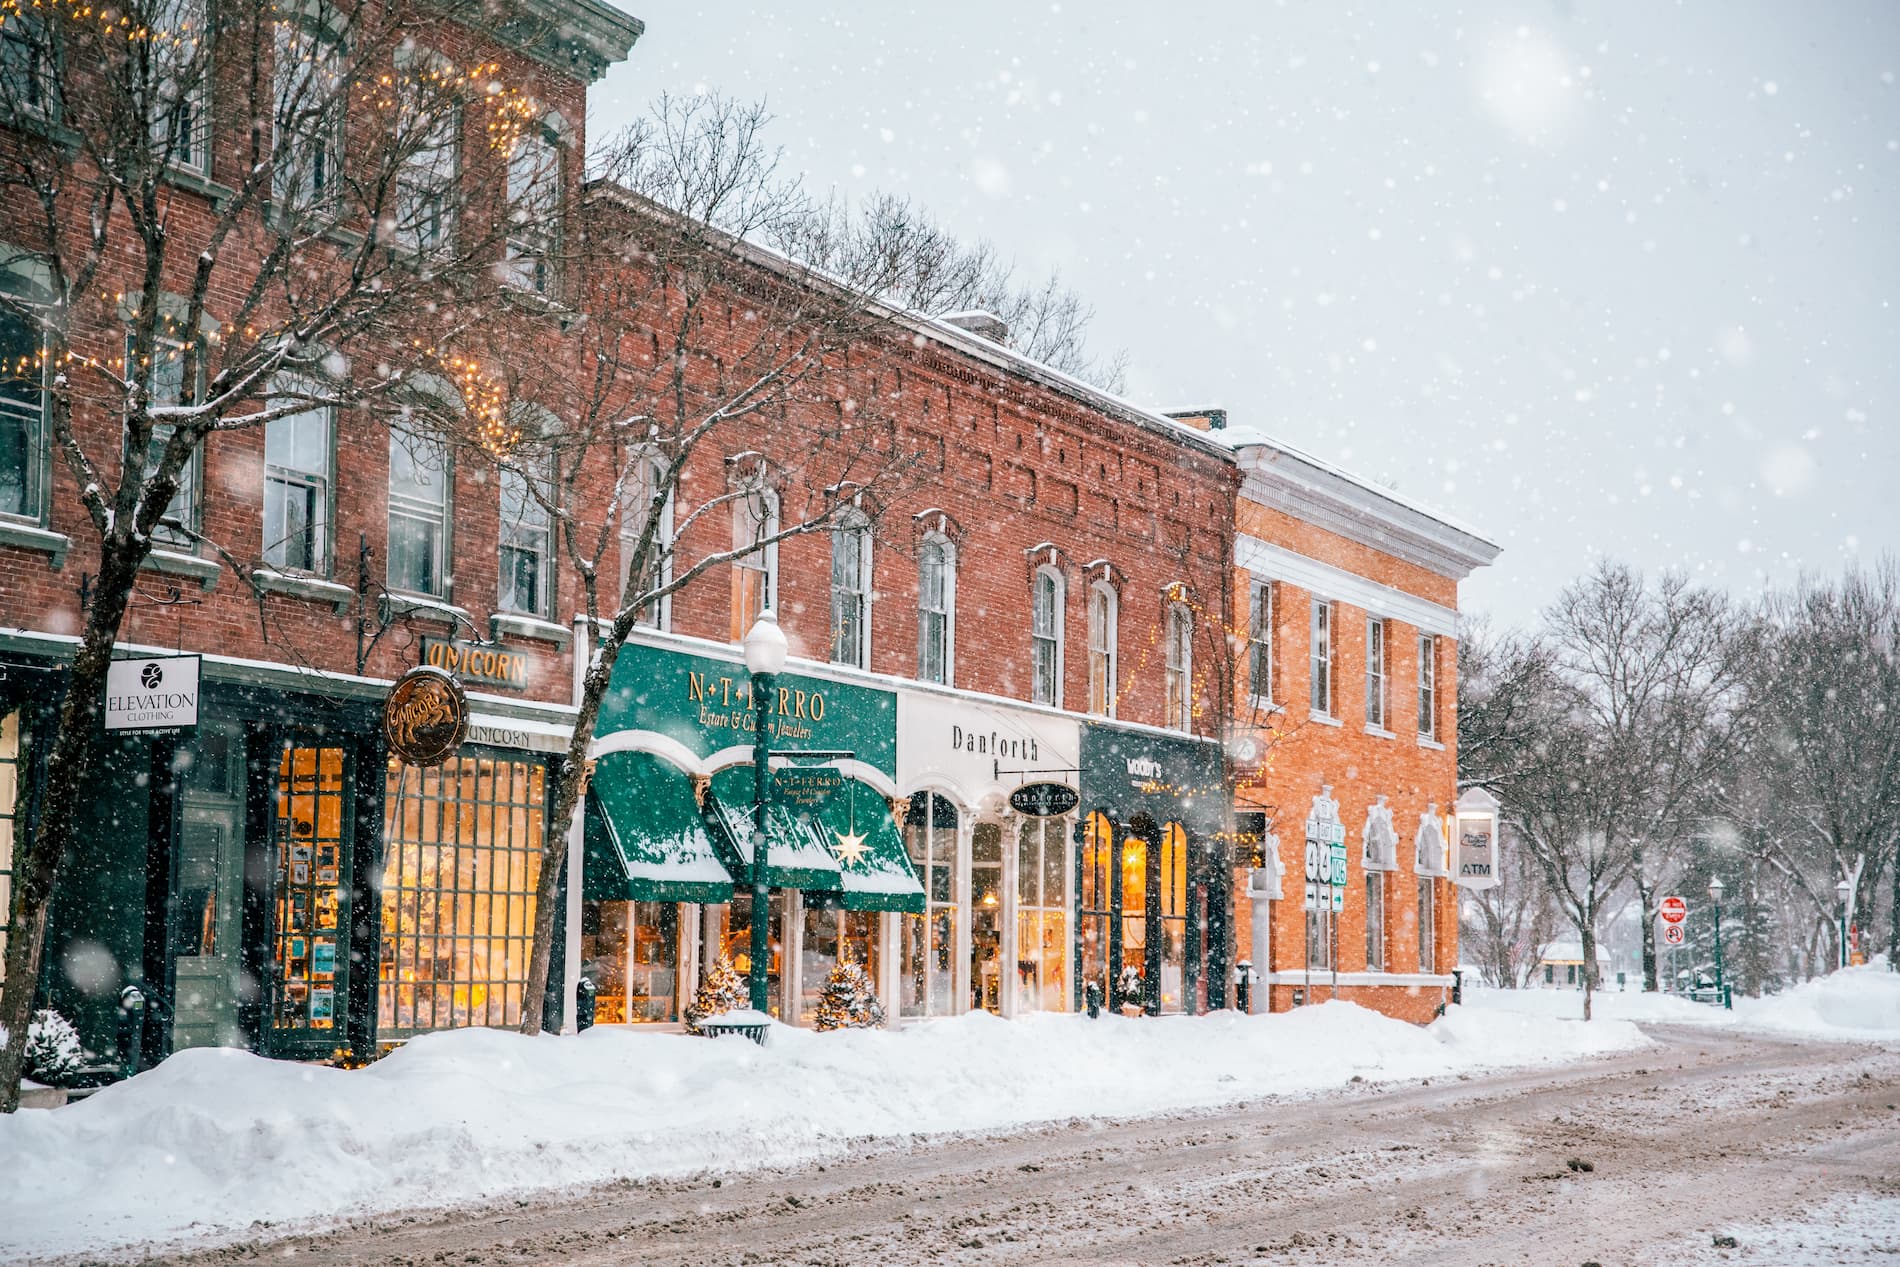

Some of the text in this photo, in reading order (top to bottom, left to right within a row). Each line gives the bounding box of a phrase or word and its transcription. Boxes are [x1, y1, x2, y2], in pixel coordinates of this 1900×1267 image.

[429, 643, 526, 681] UNICORN
[108, 693, 194, 711] ELEVATION
[127, 711, 175, 721] CLOTHING
[699, 704, 729, 728] Estate
[731, 711, 741, 729] &
[775, 718, 812, 740] Jewelers
[469, 726, 530, 747] UNICORN
[953, 725, 1038, 761] Danforth
[1308, 850, 1314, 871] 4
[1322, 853, 1328, 873] 4
[1462, 863, 1491, 875] ATM
